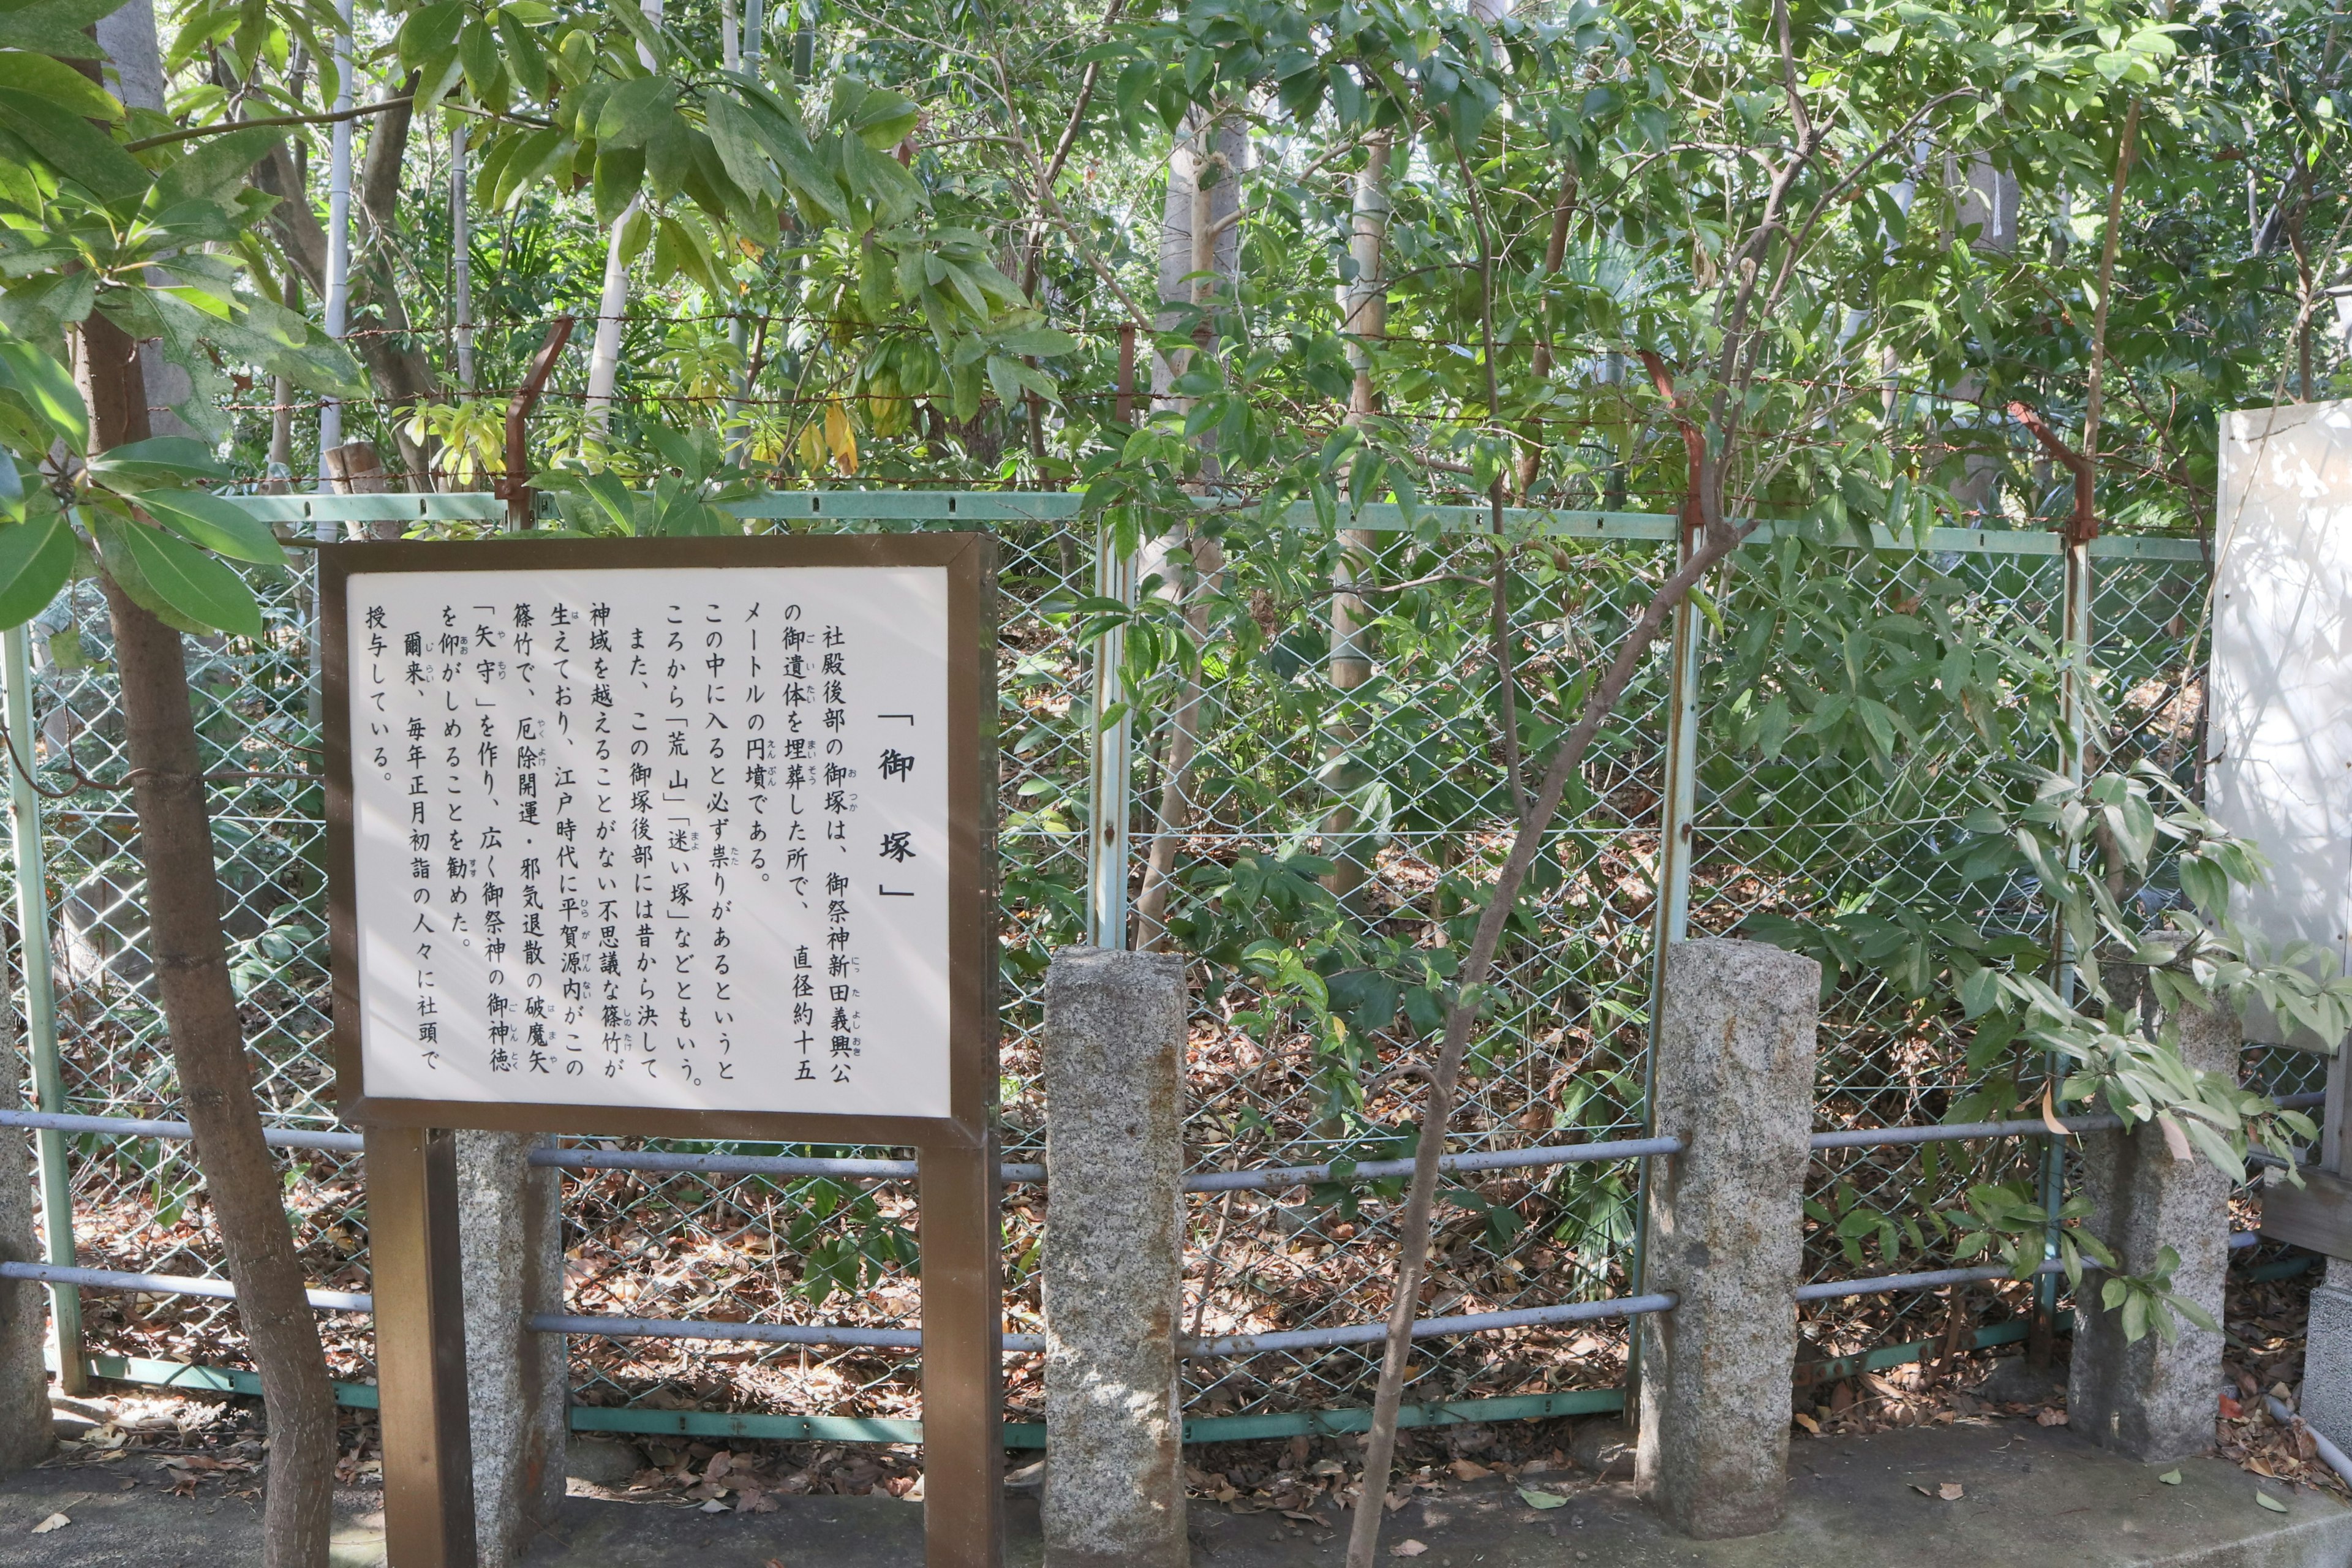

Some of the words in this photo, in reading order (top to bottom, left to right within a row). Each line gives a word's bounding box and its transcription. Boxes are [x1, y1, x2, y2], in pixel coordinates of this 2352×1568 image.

[366, 605, 391, 782] 授与している。
[439, 605, 470, 947] を仰がしめることを勧めた。
[473, 606, 511, 1072] 「矢守」を作り、広く御祭神の御神徳
[551, 603, 584, 1076] 生えており、江戸時代に平賀源内がこの
[589, 603, 624, 1078] 神域を越えることがない不思議な篠竹が
[629, 628, 658, 1079] また、この御塚後部には昔から決して
[706, 604, 734, 1080] この中に入ると必ず祟りがあるというと
[745, 602, 769, 882] メートルの円墳である。
[822, 625, 853, 1083] 社殿後部の御塚は、御祭神新田義興公
[878, 715, 917, 896] 「御塚」
